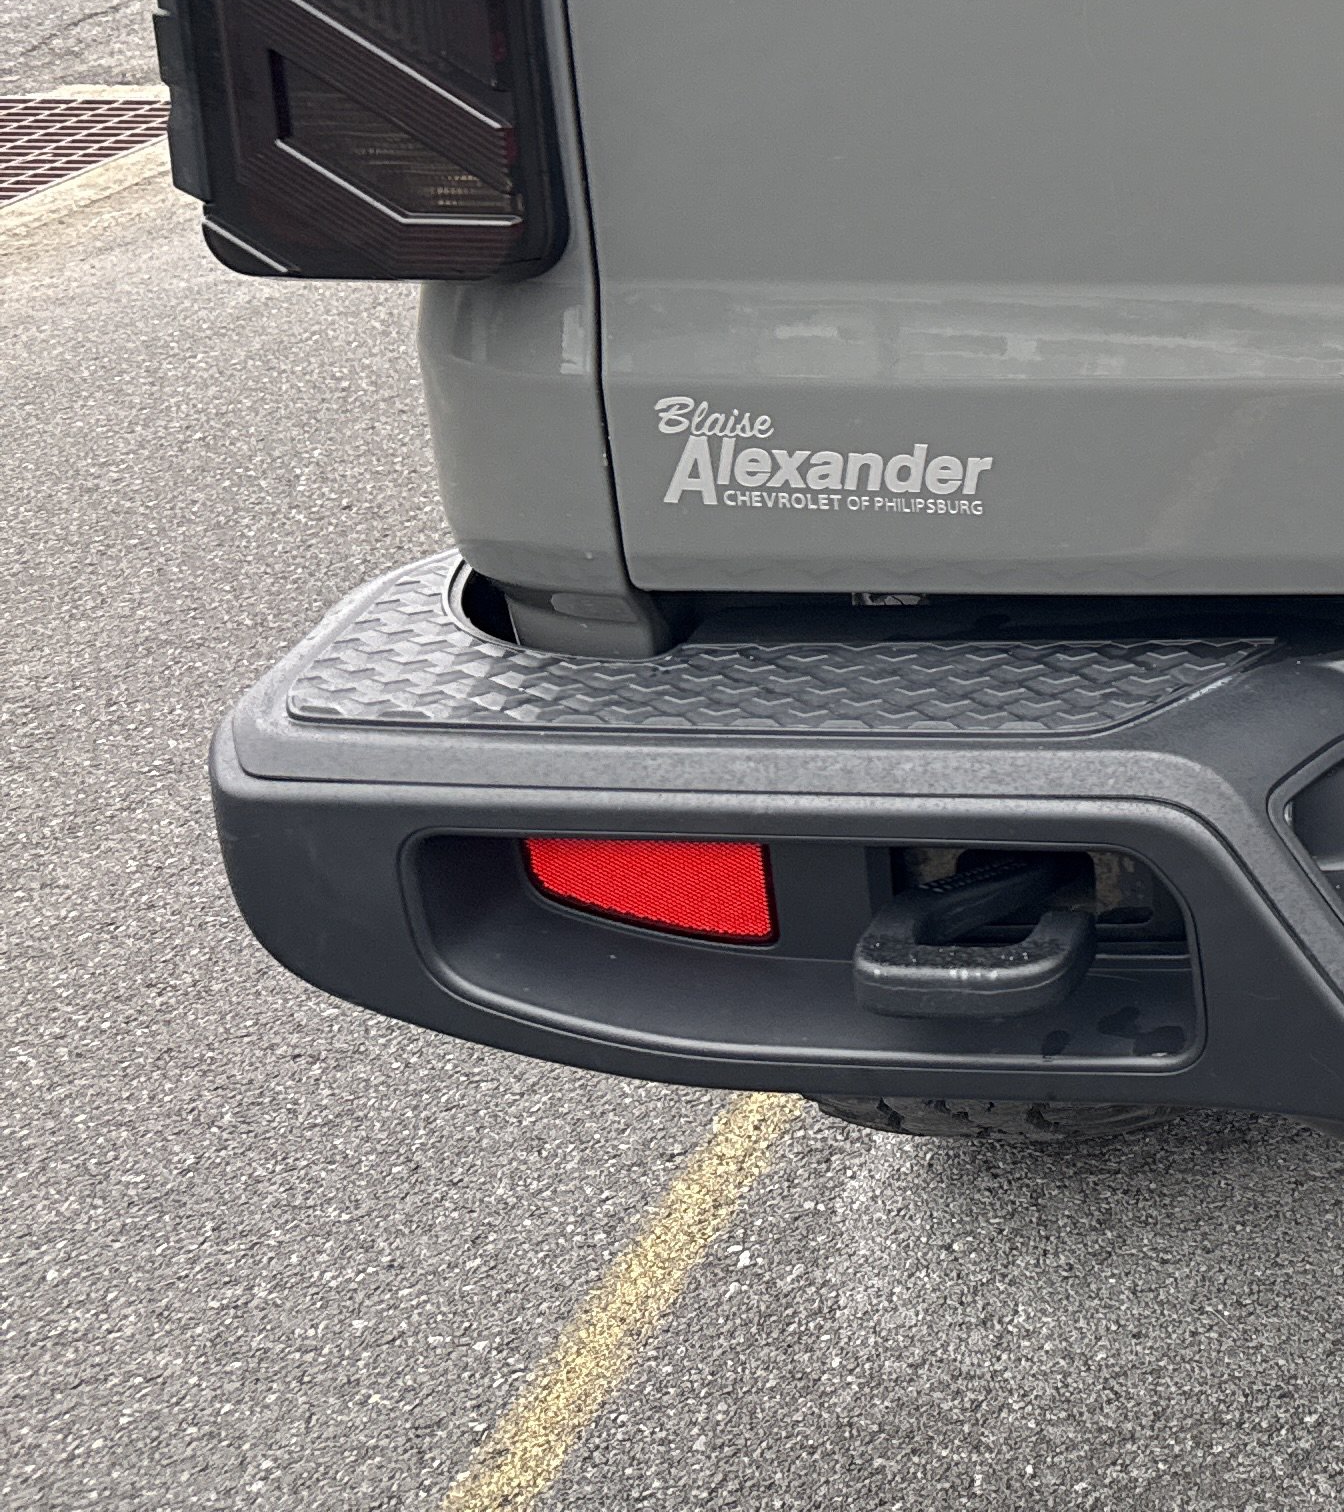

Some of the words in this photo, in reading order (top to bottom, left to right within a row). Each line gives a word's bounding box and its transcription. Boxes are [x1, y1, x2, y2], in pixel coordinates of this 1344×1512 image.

[654, 396, 775, 439] Blaise
[663, 434, 993, 506] Alexander
[723, 490, 840, 511] CHEVROLET
[847, 496, 871, 512] OF
[874, 497, 984, 516] PHILIPSBURG
